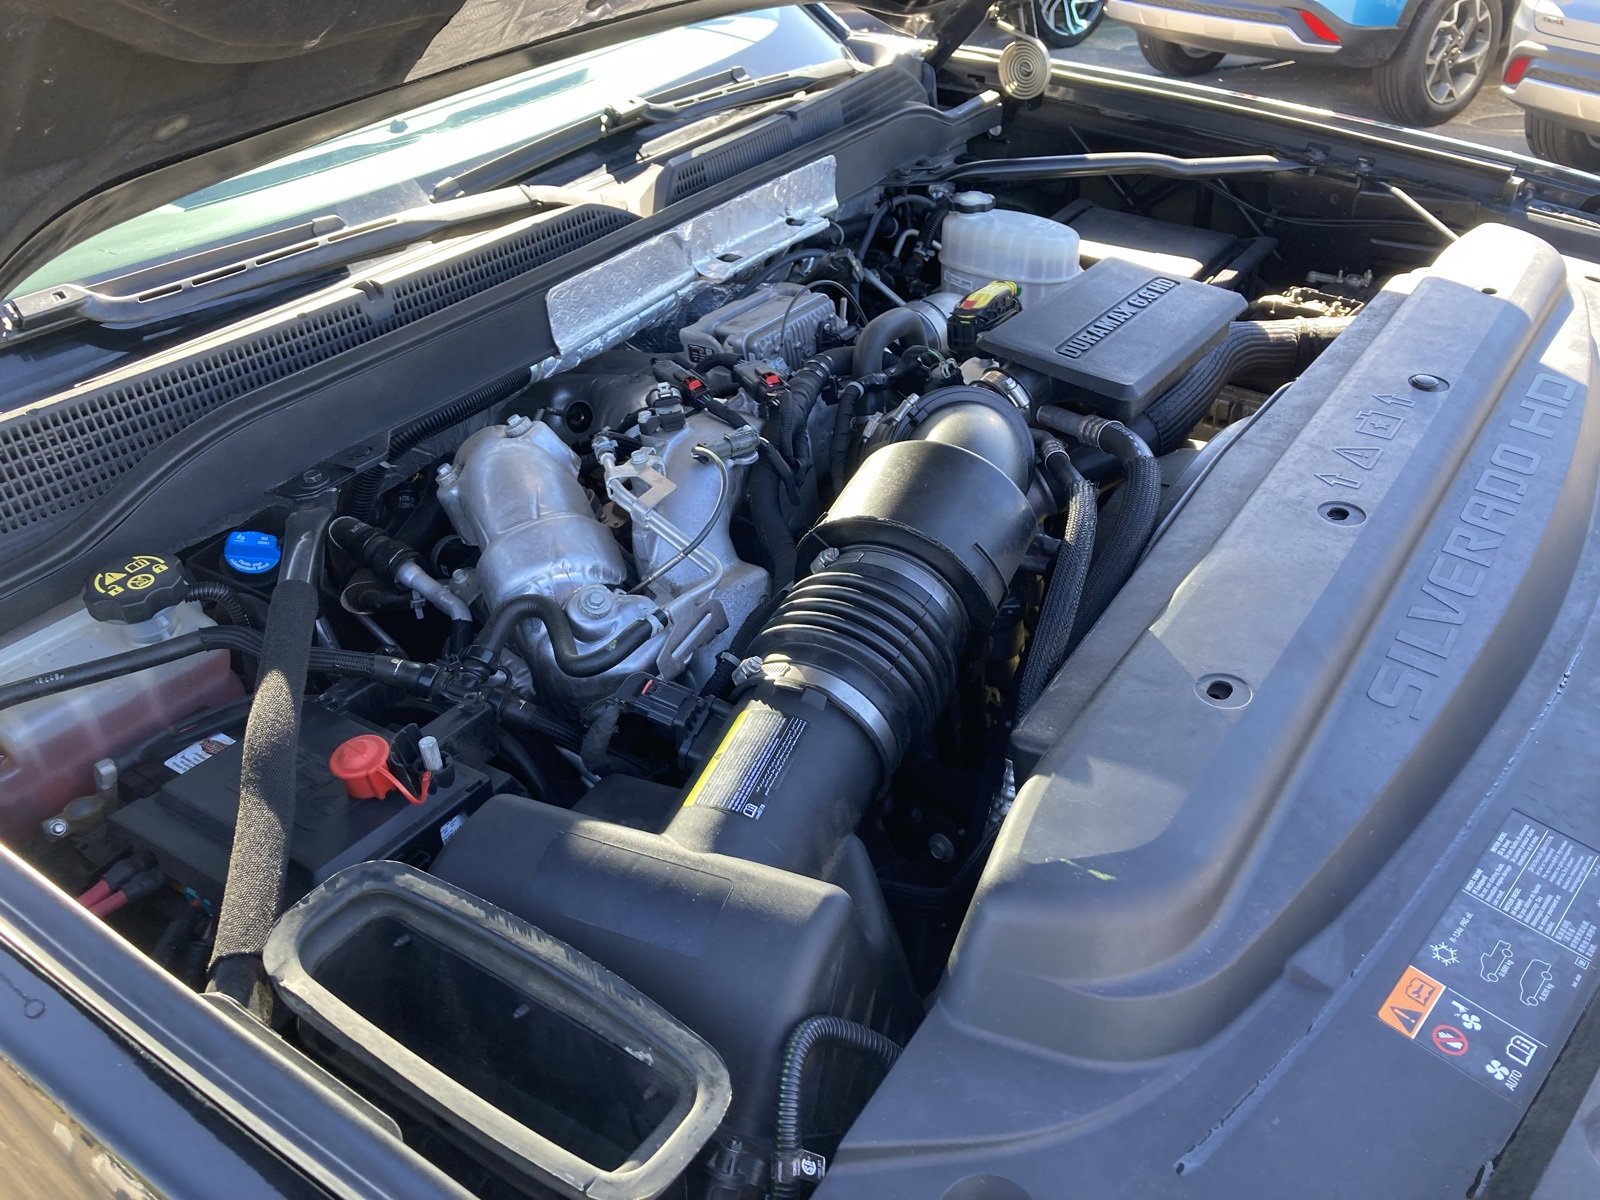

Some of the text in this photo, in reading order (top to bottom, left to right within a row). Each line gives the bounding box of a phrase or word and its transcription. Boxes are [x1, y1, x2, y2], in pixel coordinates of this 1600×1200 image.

[1058, 277, 1177, 359] DURAMAX 6.6 HD
[1366, 372, 1578, 721] SILVERADO HD
[1505, 1069, 1523, 1092] AUTO
